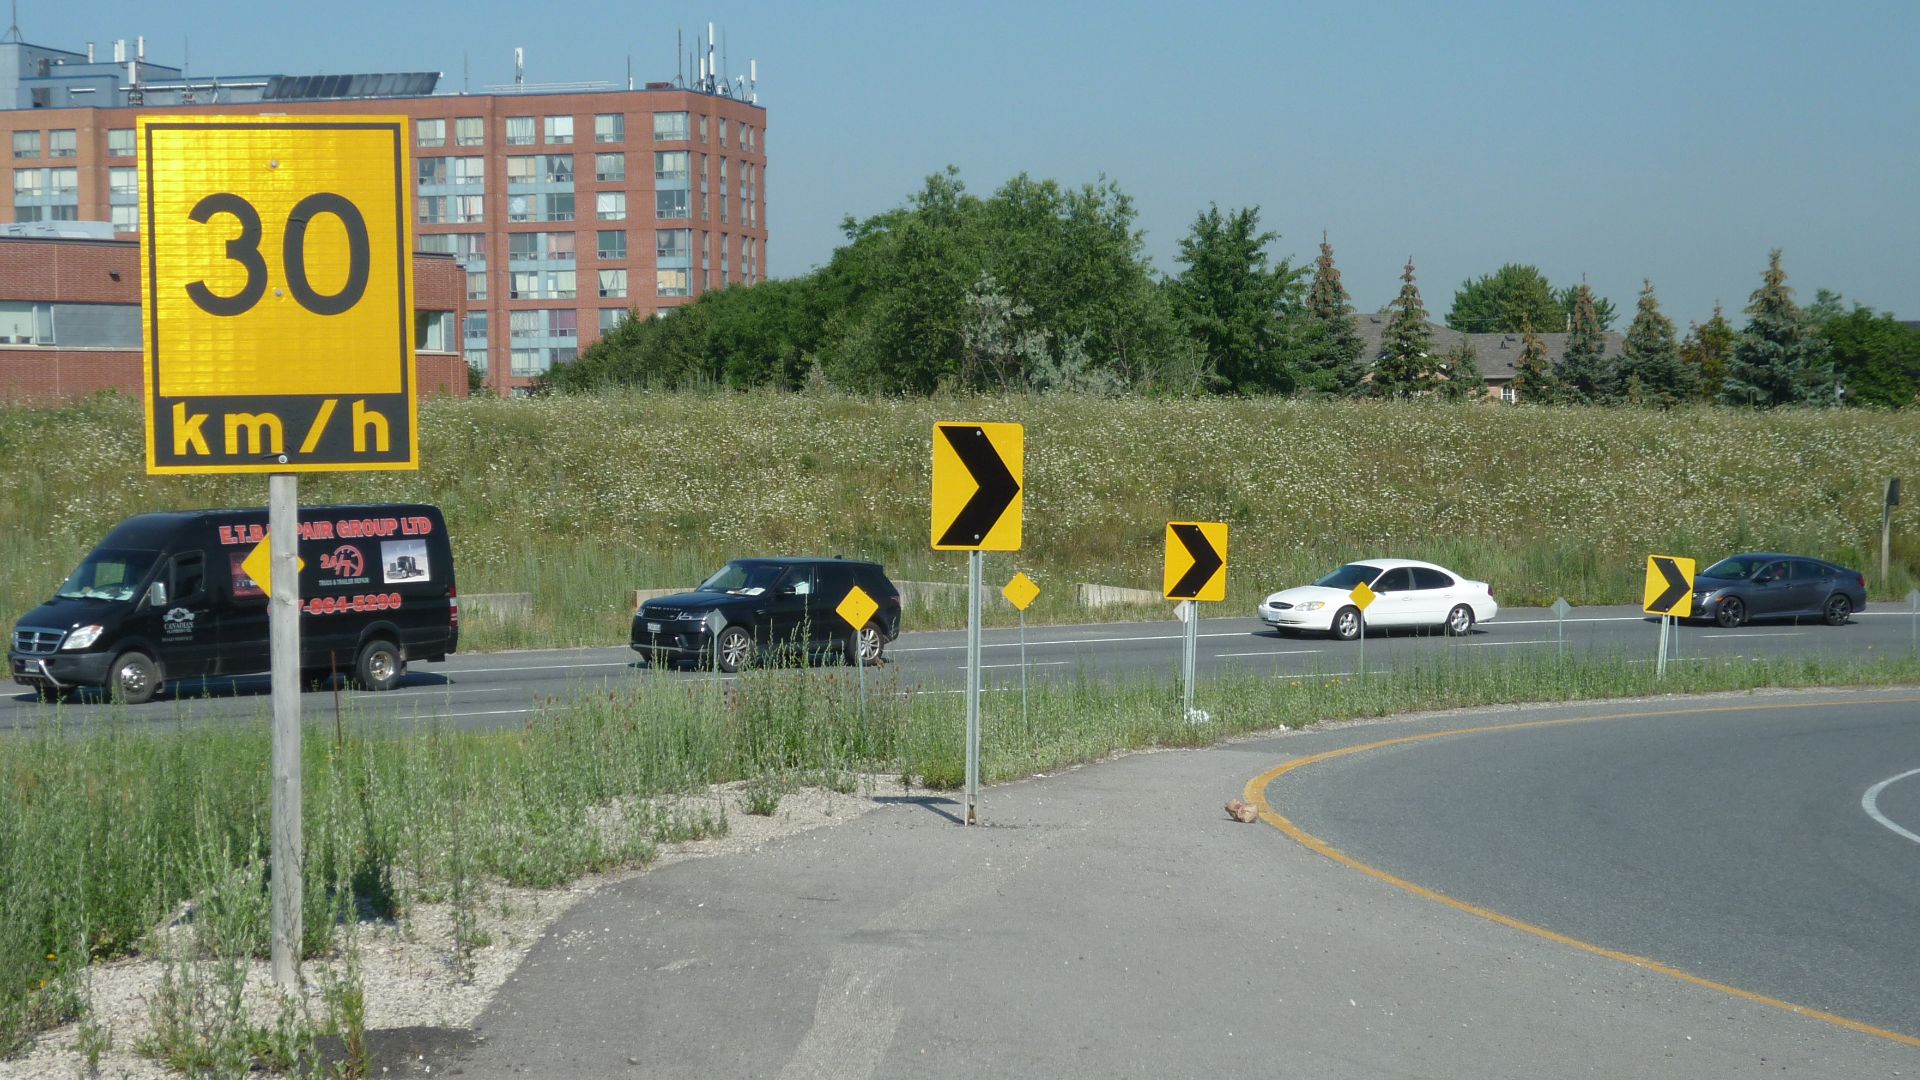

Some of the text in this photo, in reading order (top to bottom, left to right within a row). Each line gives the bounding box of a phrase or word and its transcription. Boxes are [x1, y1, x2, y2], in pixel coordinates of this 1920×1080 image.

[185, 192, 370, 317] 30
[172, 399, 390, 455] km/h
[336, 519, 398, 538] GROUP
[400, 516, 432, 535] LTD
